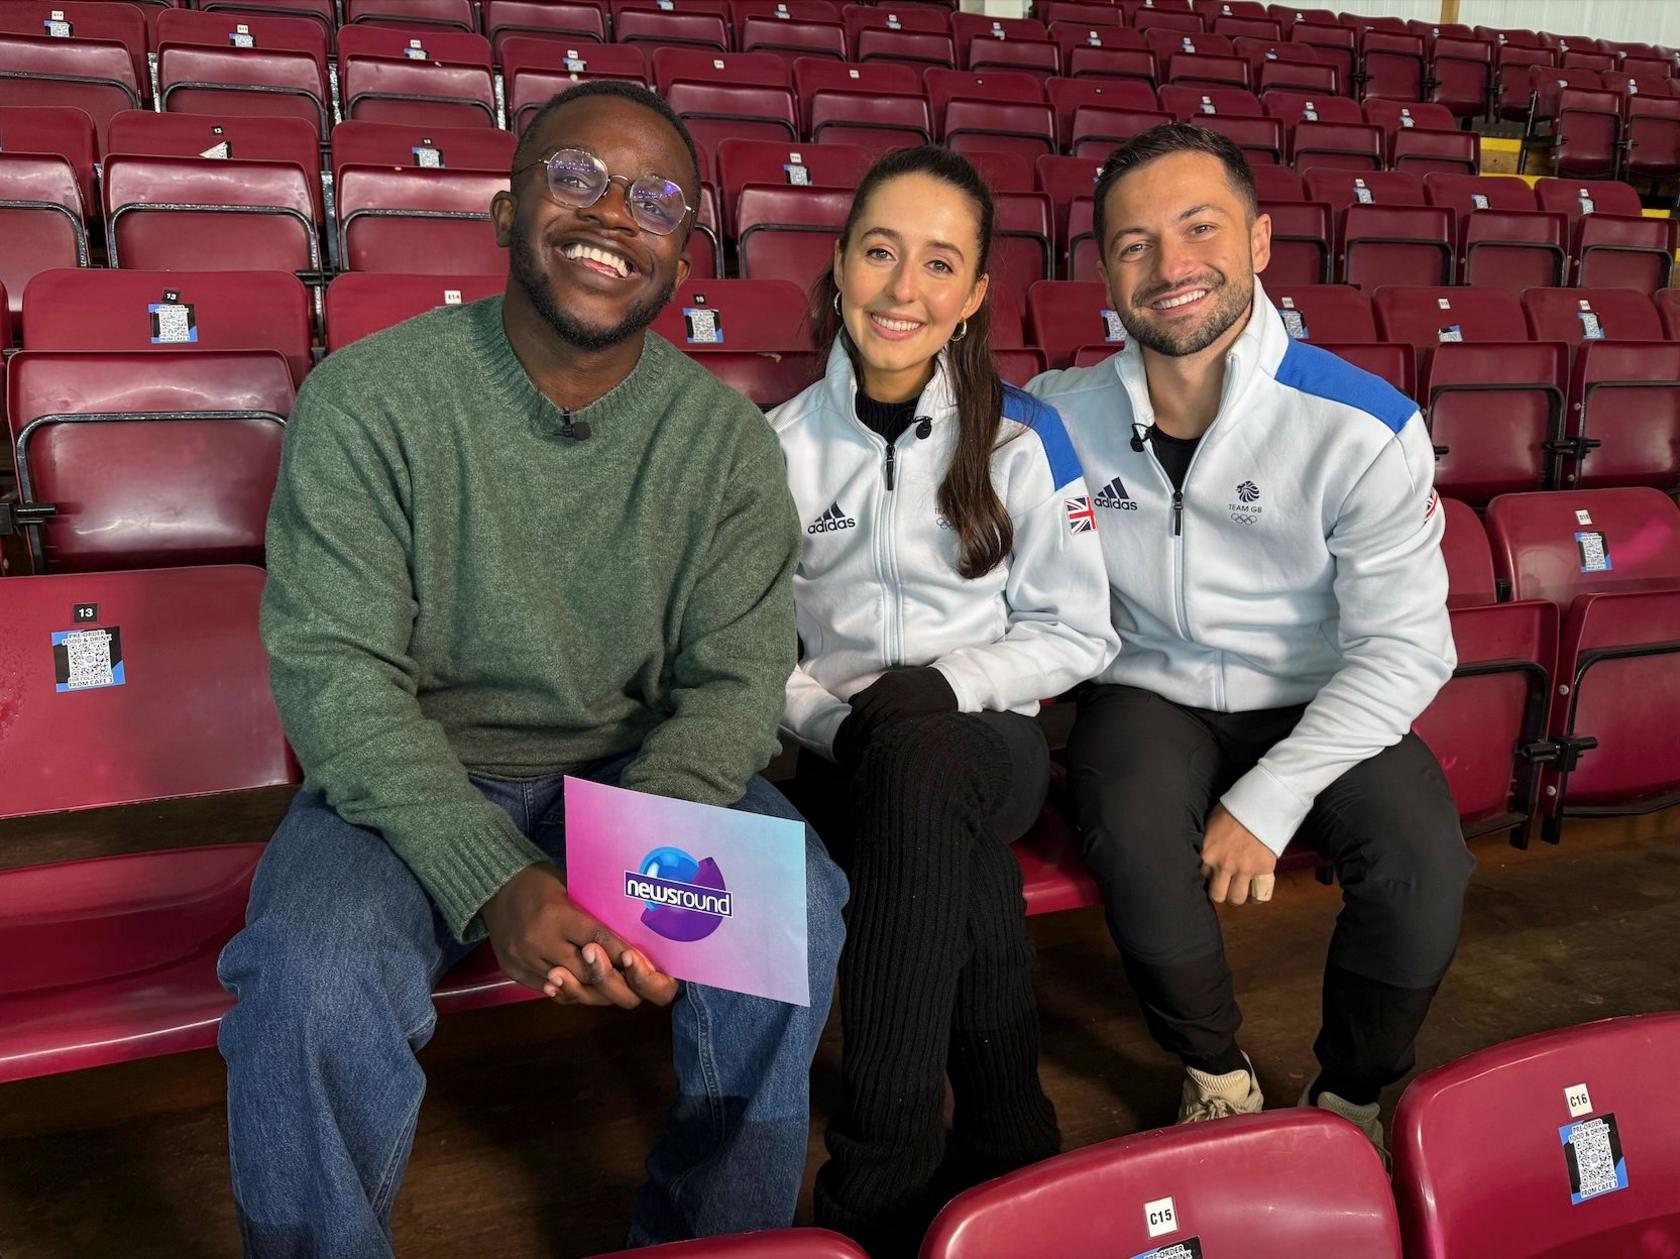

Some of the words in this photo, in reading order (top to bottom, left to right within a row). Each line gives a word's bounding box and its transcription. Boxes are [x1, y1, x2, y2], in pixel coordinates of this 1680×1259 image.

[1094, 498, 1138, 511] adidas
[1228, 504, 1249, 512] TEAM
[808, 518, 856, 534] adidas
[79, 607, 93, 617] 13
[627, 879, 730, 915] newsround
[1570, 1093, 1588, 1107] C16
[1150, 1209, 1172, 1225] C15
